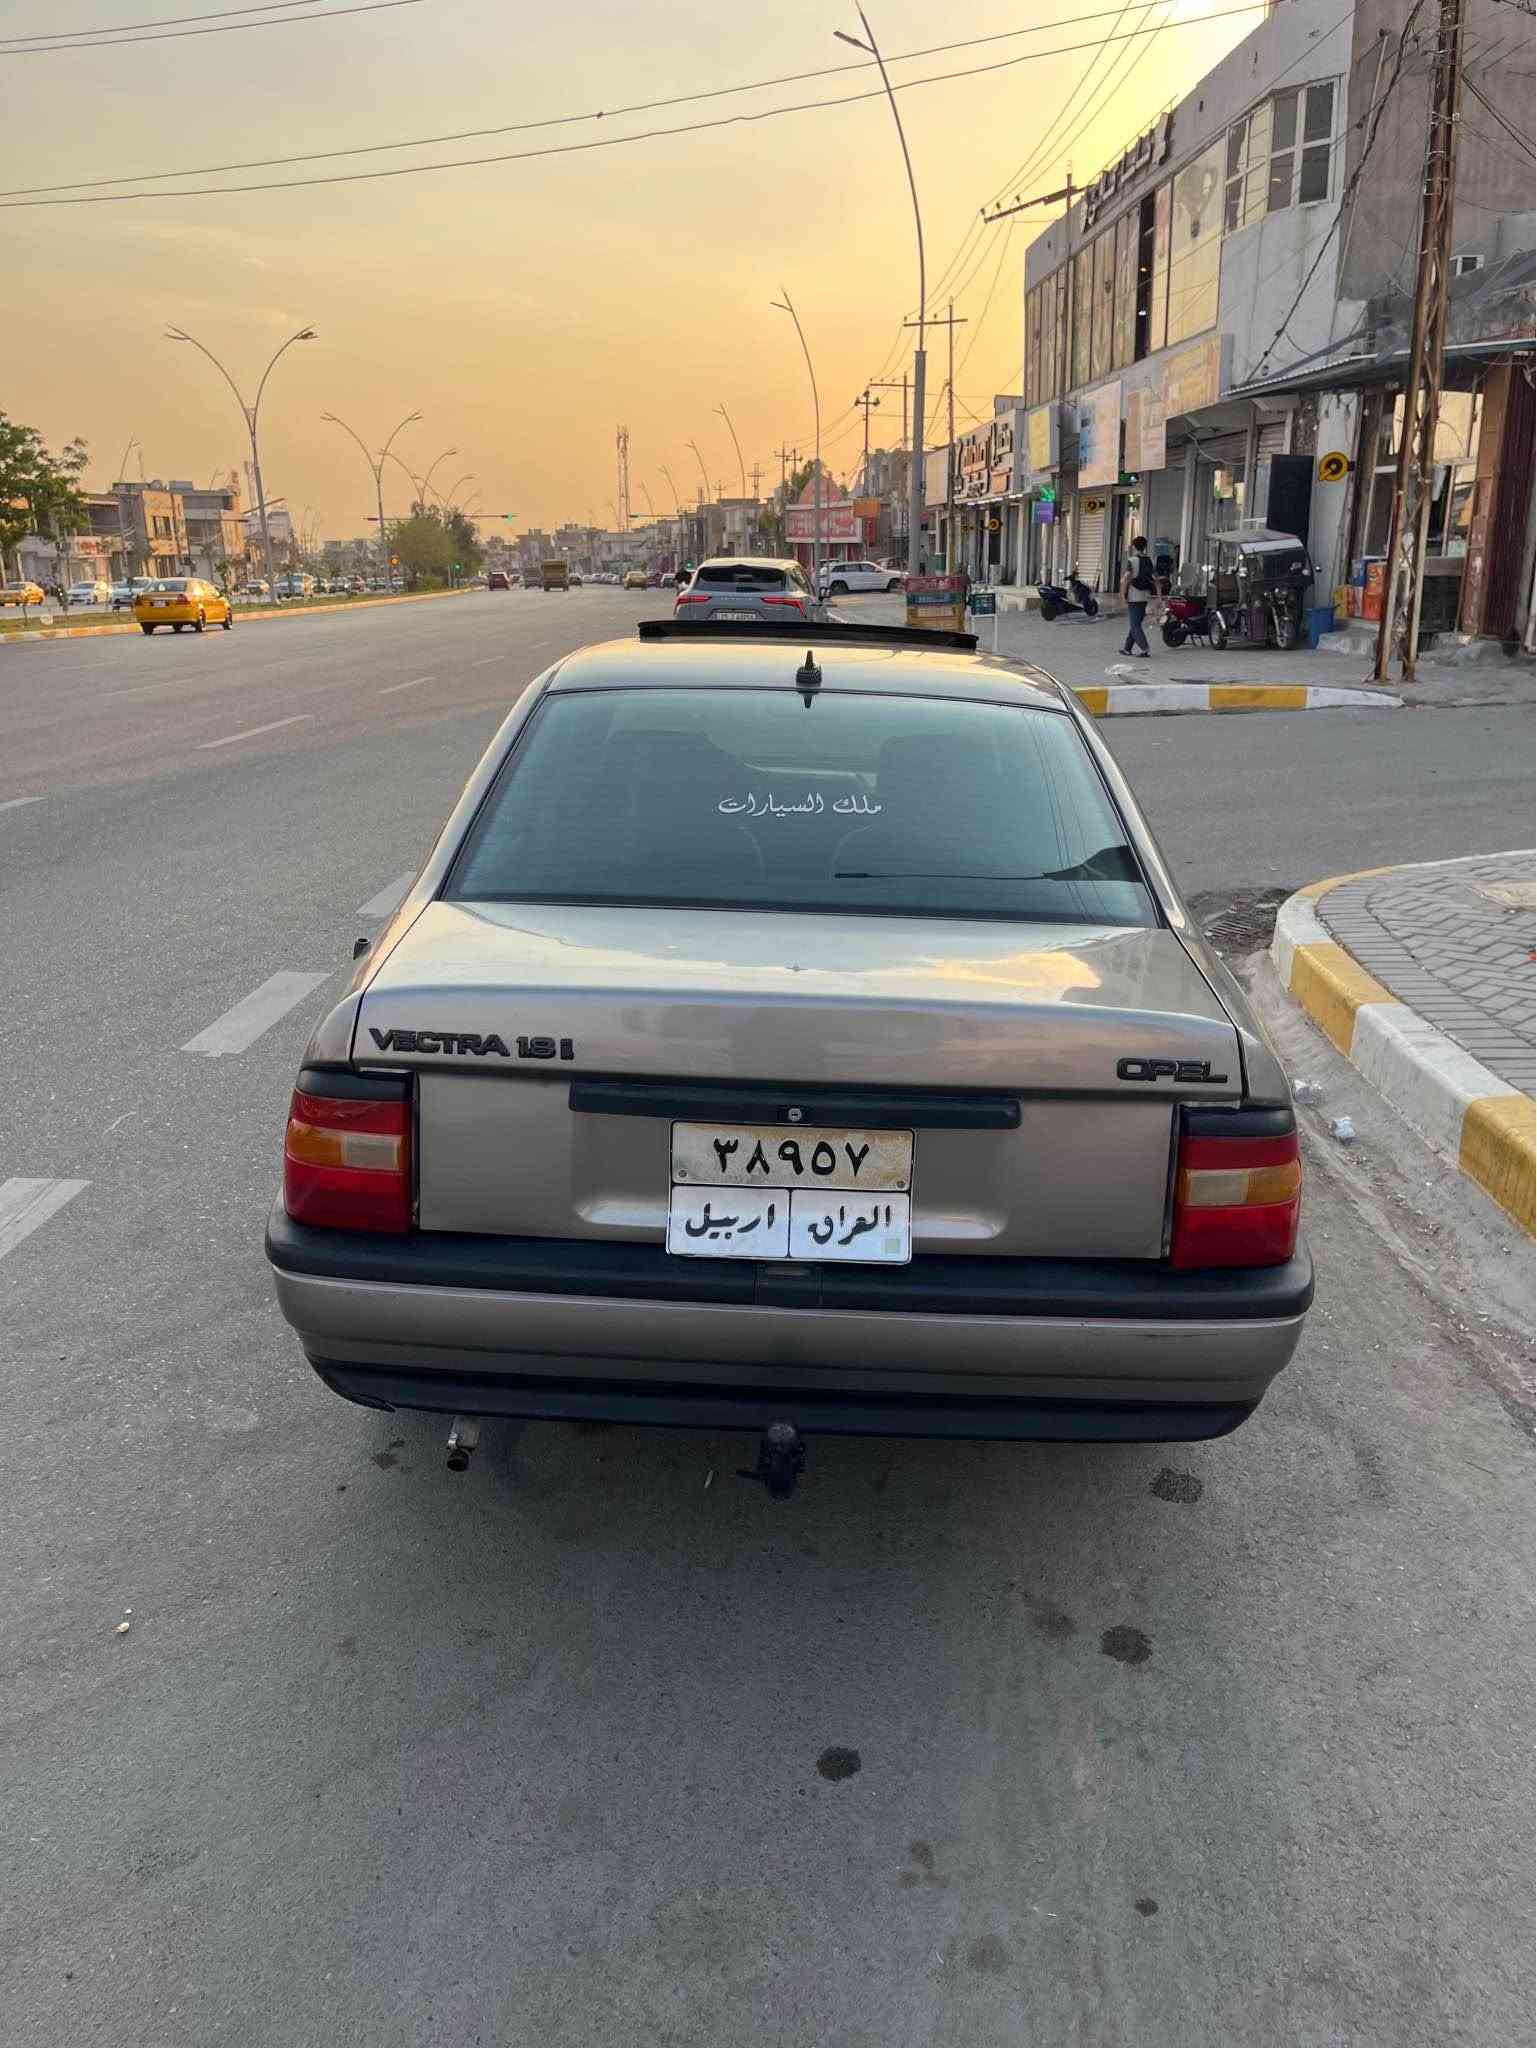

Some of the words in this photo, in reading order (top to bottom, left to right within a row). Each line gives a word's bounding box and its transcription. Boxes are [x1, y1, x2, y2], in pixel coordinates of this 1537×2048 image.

[718, 792, 824, 817] السيارات
[832, 794, 882, 814] ملك
[368, 1027, 511, 1057] VECTRA
[1117, 1058, 1228, 1083] OPEL
[713, 1137, 870, 1177] ٣٨٩٥٧
